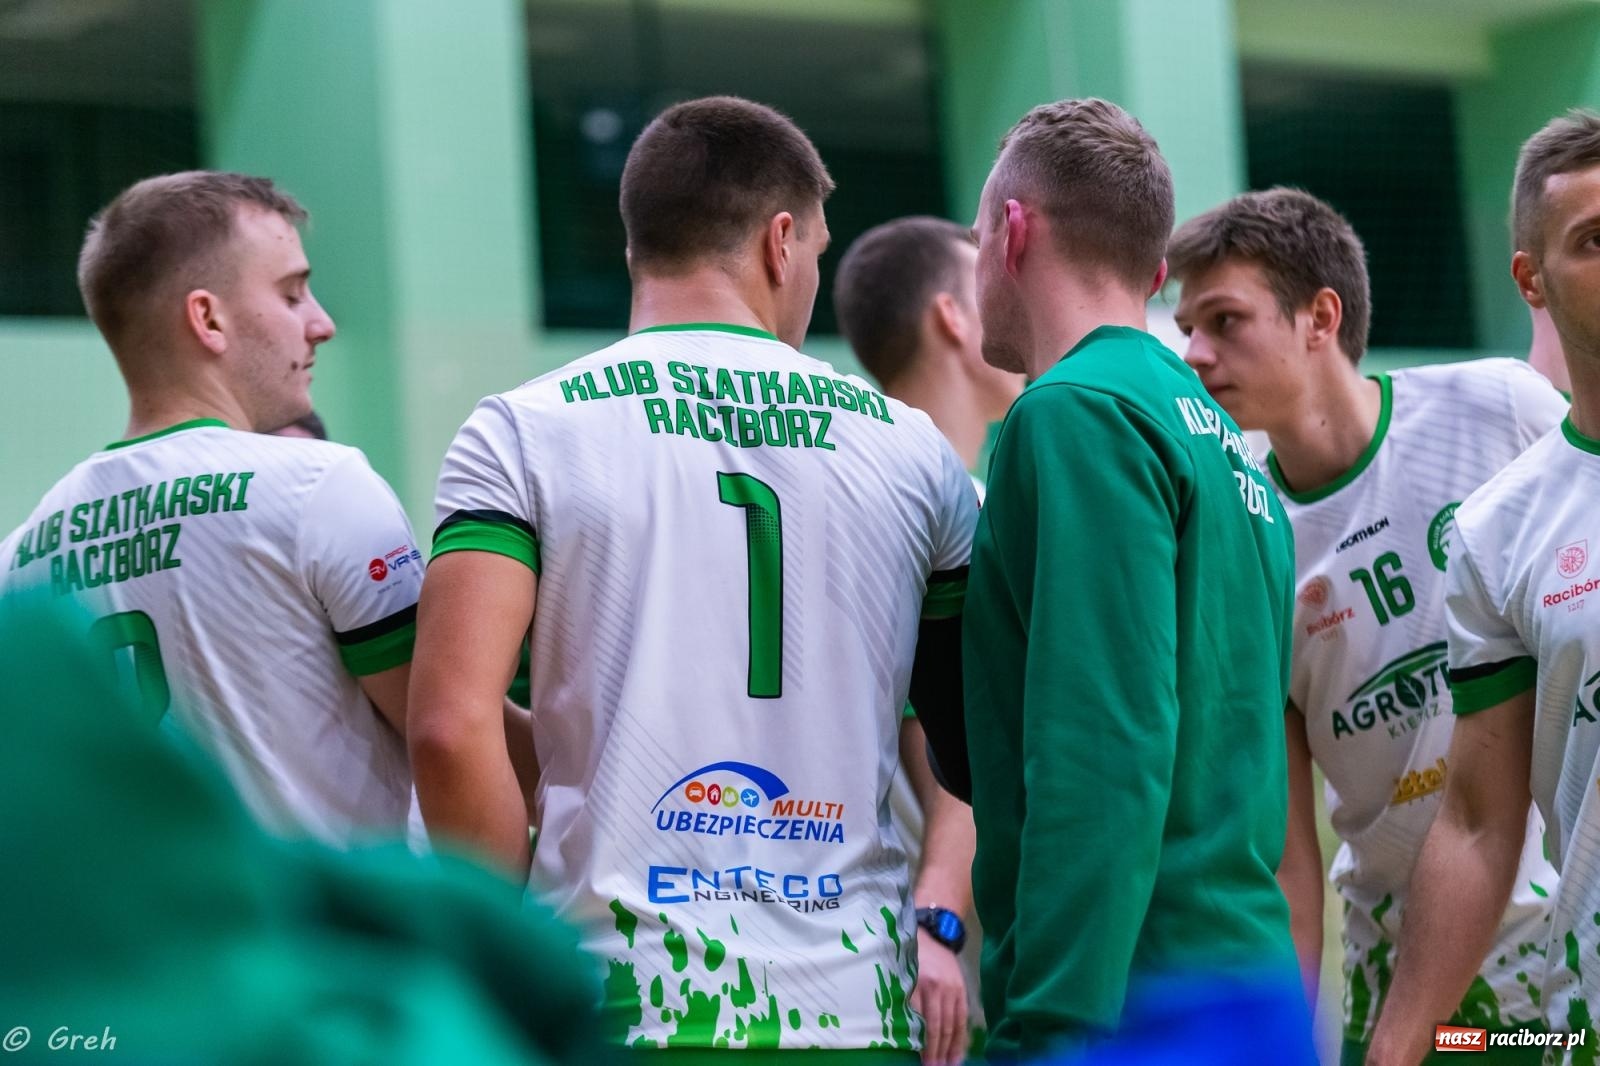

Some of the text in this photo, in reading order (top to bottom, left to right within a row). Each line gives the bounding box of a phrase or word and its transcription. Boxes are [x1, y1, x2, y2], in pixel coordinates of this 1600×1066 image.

[560, 360, 895, 424] KLUB SIATKARSKI
[643, 397, 837, 450] RACIBÓRZ
[69, 472, 255, 543] SIATKARSKI
[50, 523, 182, 596] RACIBÓRZ
[716, 471, 784, 699] 1
[1349, 551, 1416, 626] 16
[656, 809, 844, 843] UBEZPIECZENIA
[771, 800, 844, 819] MULTI
[648, 865, 843, 904] ENTECO
